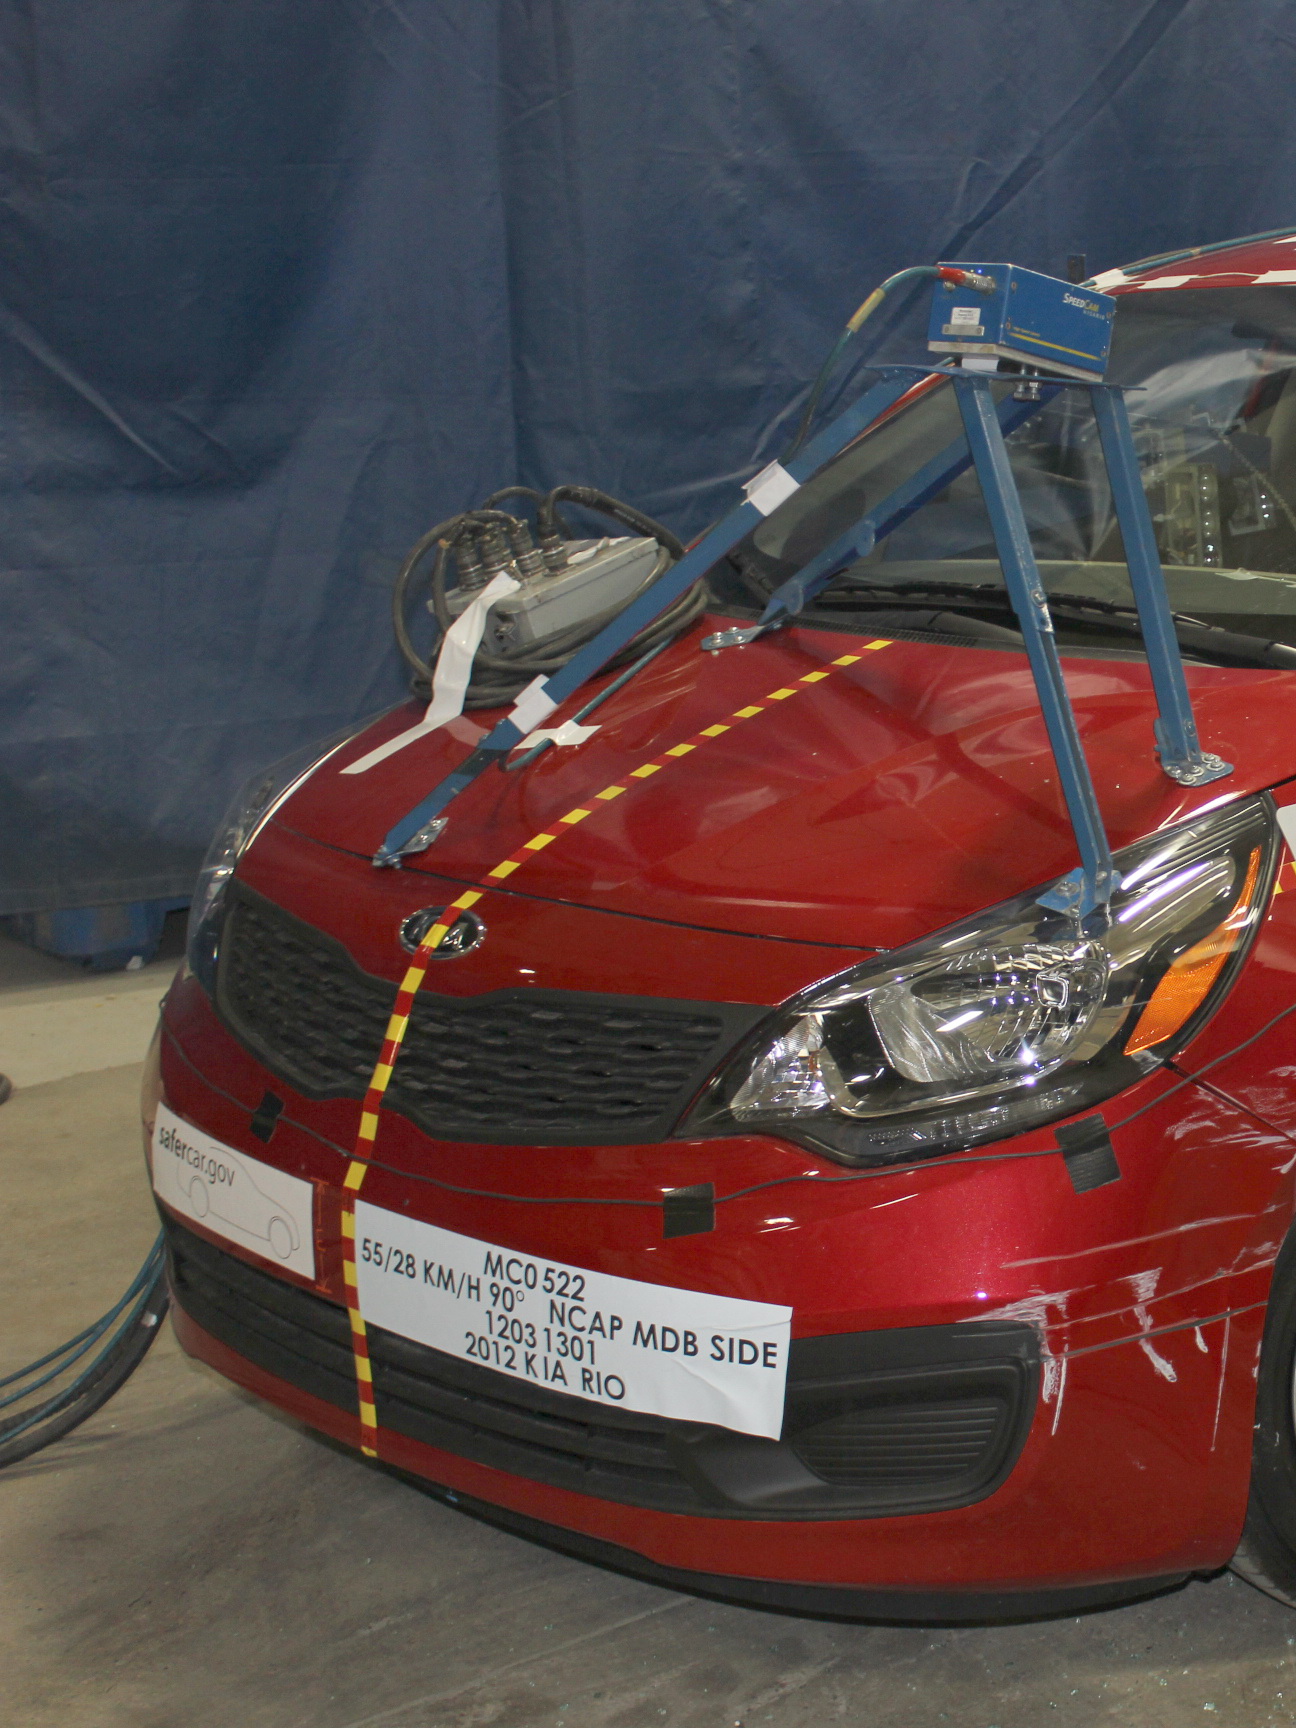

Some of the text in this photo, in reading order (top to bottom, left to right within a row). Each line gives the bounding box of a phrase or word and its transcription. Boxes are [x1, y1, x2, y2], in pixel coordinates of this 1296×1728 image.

[158, 1126, 235, 1187] safercar.gov
[361, 1237, 417, 1279] 55/28
[423, 1259, 481, 1302] KM/H
[549, 1299, 624, 1341] NCAP
[632, 1320, 699, 1357] MDB
[710, 1334, 778, 1369] SIDE
[465, 1331, 626, 1400] 2012 KIA RIO
